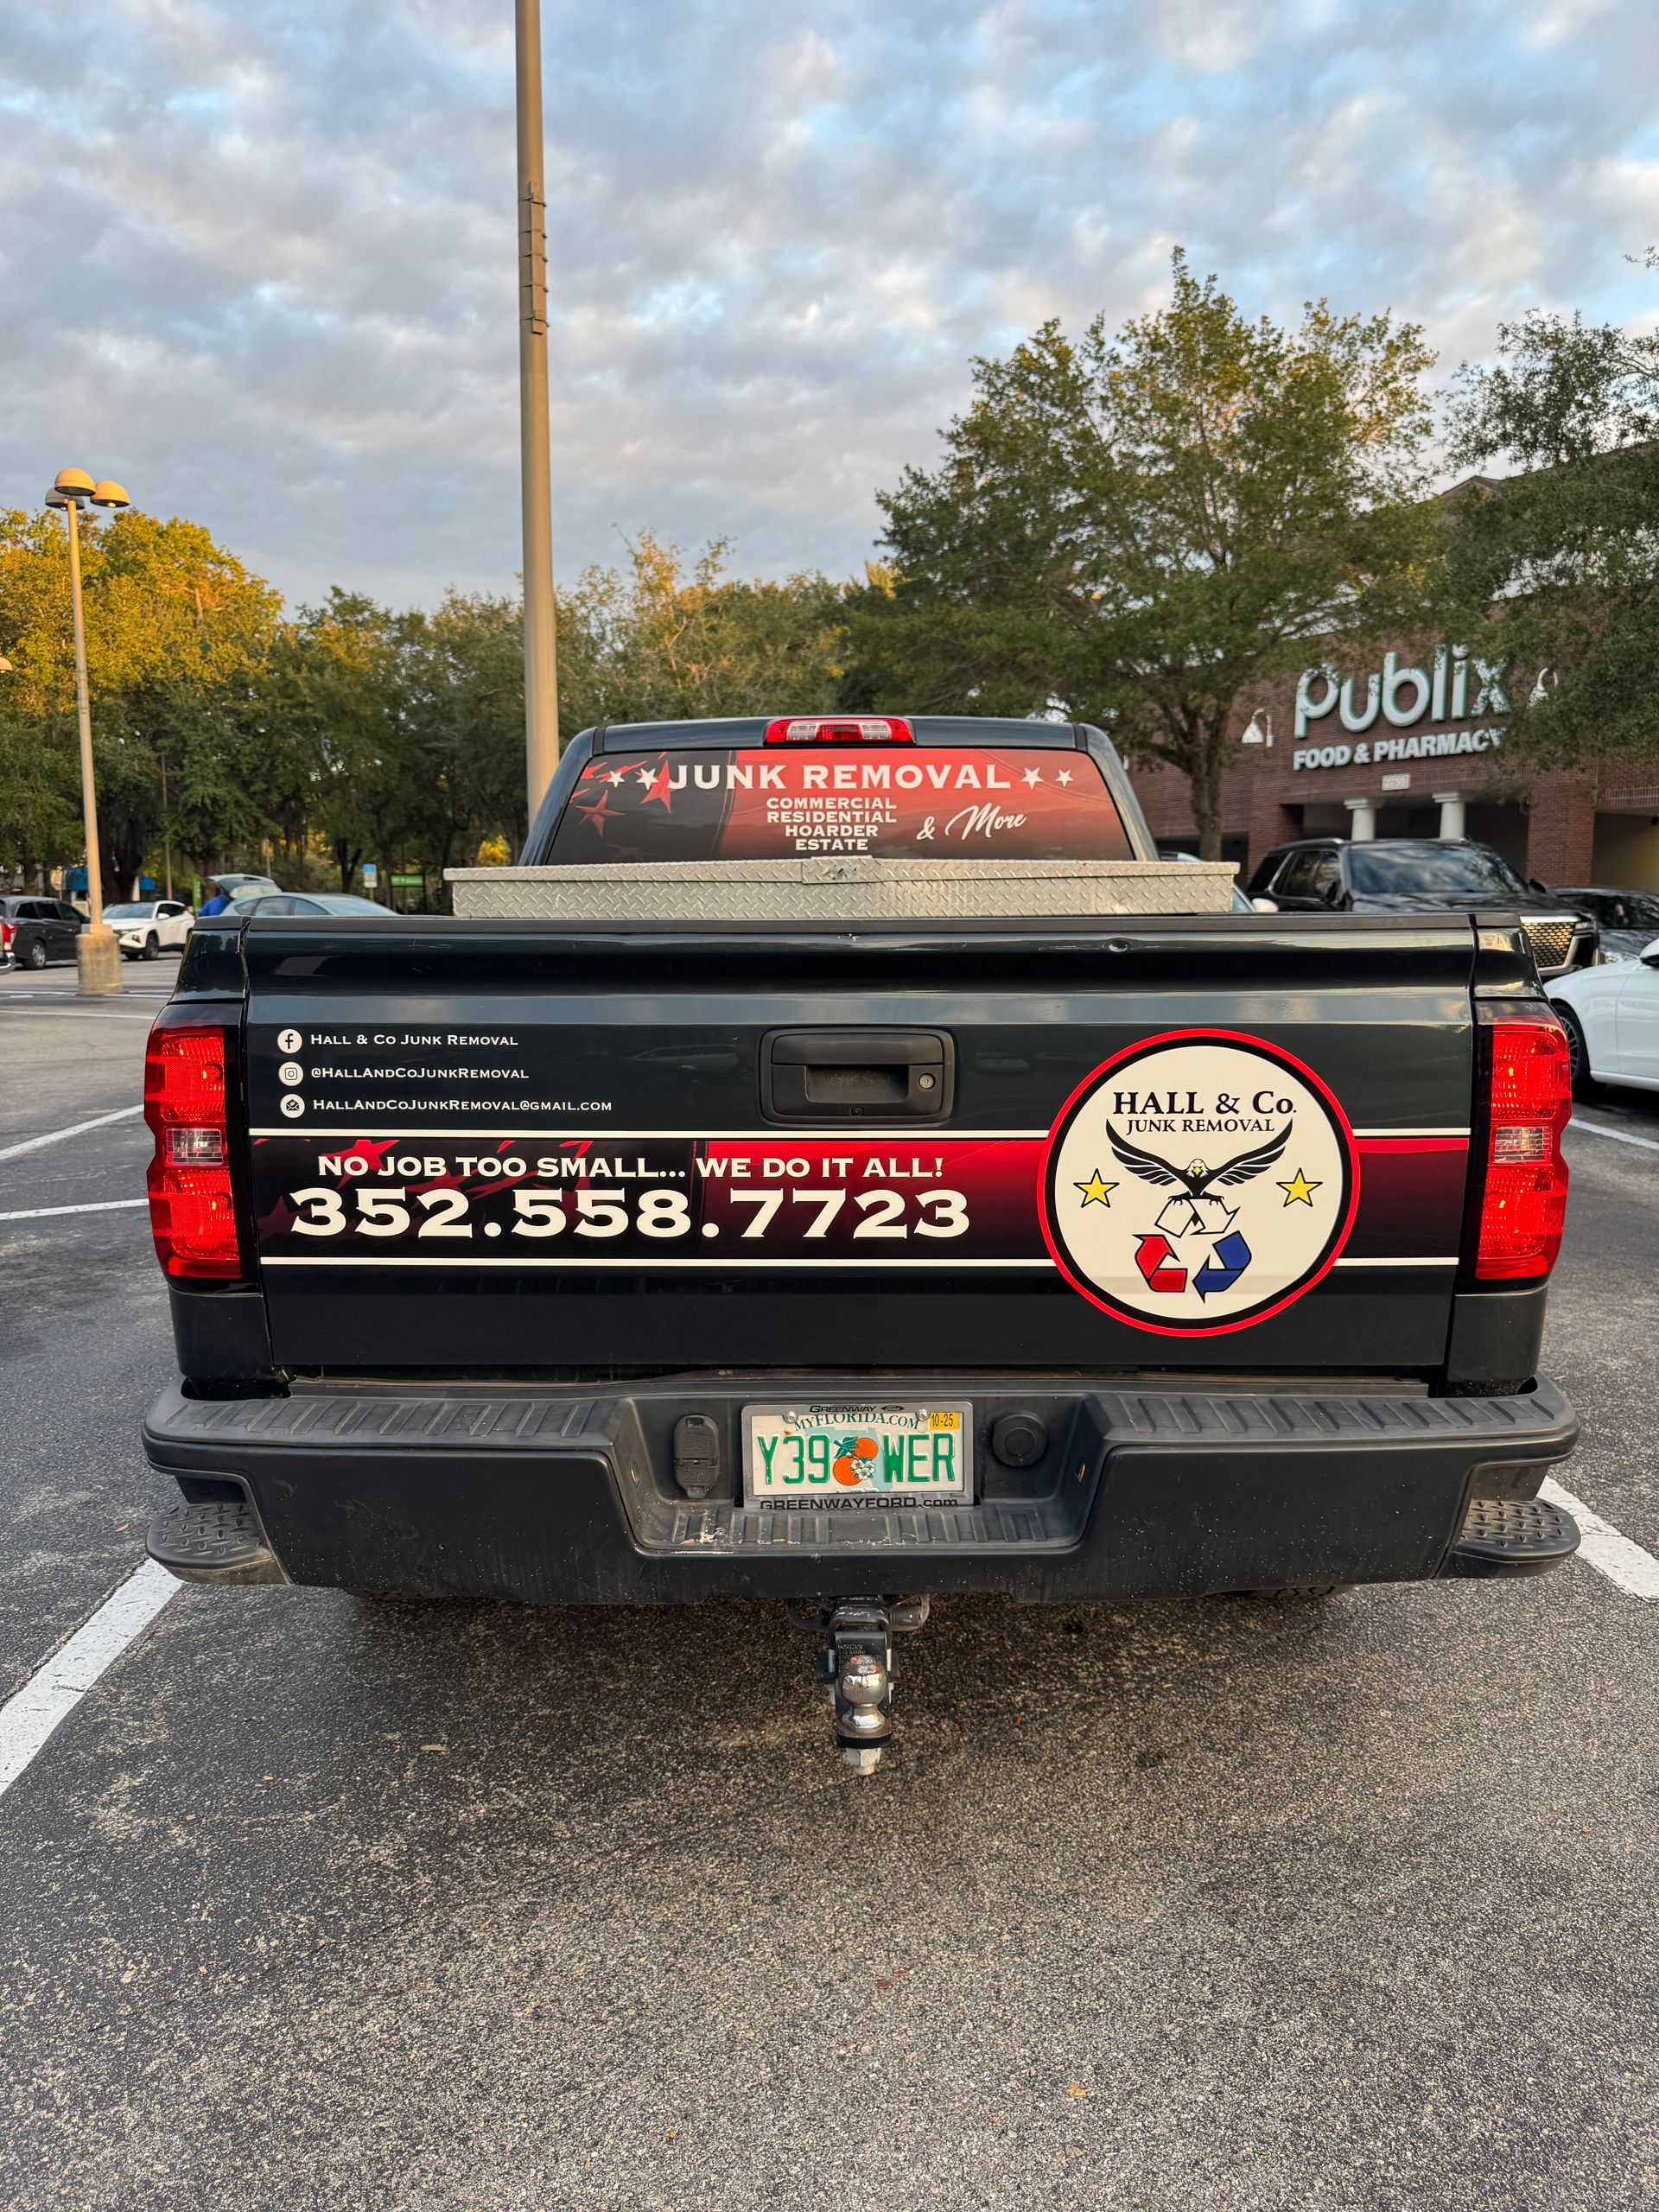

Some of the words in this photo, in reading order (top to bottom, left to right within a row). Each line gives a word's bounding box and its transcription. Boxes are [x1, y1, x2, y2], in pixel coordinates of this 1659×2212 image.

[1293, 745, 1352, 771] FOOD
[1353, 742, 1371, 764] &
[667, 764, 789, 790] JUNK
[802, 764, 1011, 790] REMOVAL
[766, 797, 897, 810] COMMERCIAL
[766, 810, 897, 823] RESIDENTIAL
[916, 817, 936, 841] &
[944, 802, 1027, 841] More
[785, 824, 879, 837] HOARDER
[795, 838, 868, 851] ESTATE
[356, 1034, 368, 1045] &
[1113, 1091, 1204, 1115] HALL
[1216, 1092, 1240, 1115] &
[1252, 1090, 1297, 1115] Co.
[1126, 1119, 1176, 1135] JUNK
[1182, 1119, 1274, 1133] REMOVAL
[318, 1156, 369, 1177] NO
[378, 1156, 447, 1177] JOB
[455, 1156, 527, 1177] TOO
[537, 1157, 685, 1178] SMALL...
[695, 1158, 752, 1178] WE
[762, 1158, 810, 1178] DO
[822, 1158, 854, 1178] IT
[862, 1158, 944, 1178] ALL!
[289, 1186, 969, 1239] 352.558.7723
[809, 1405, 877, 1414] GREENWAY
[931, 1414, 953, 1427] 10-25
[757, 1434, 830, 1484] Y39
[883, 1433, 956, 1484] WER
[760, 1497, 958, 1510] GREENWAYFORD.com
